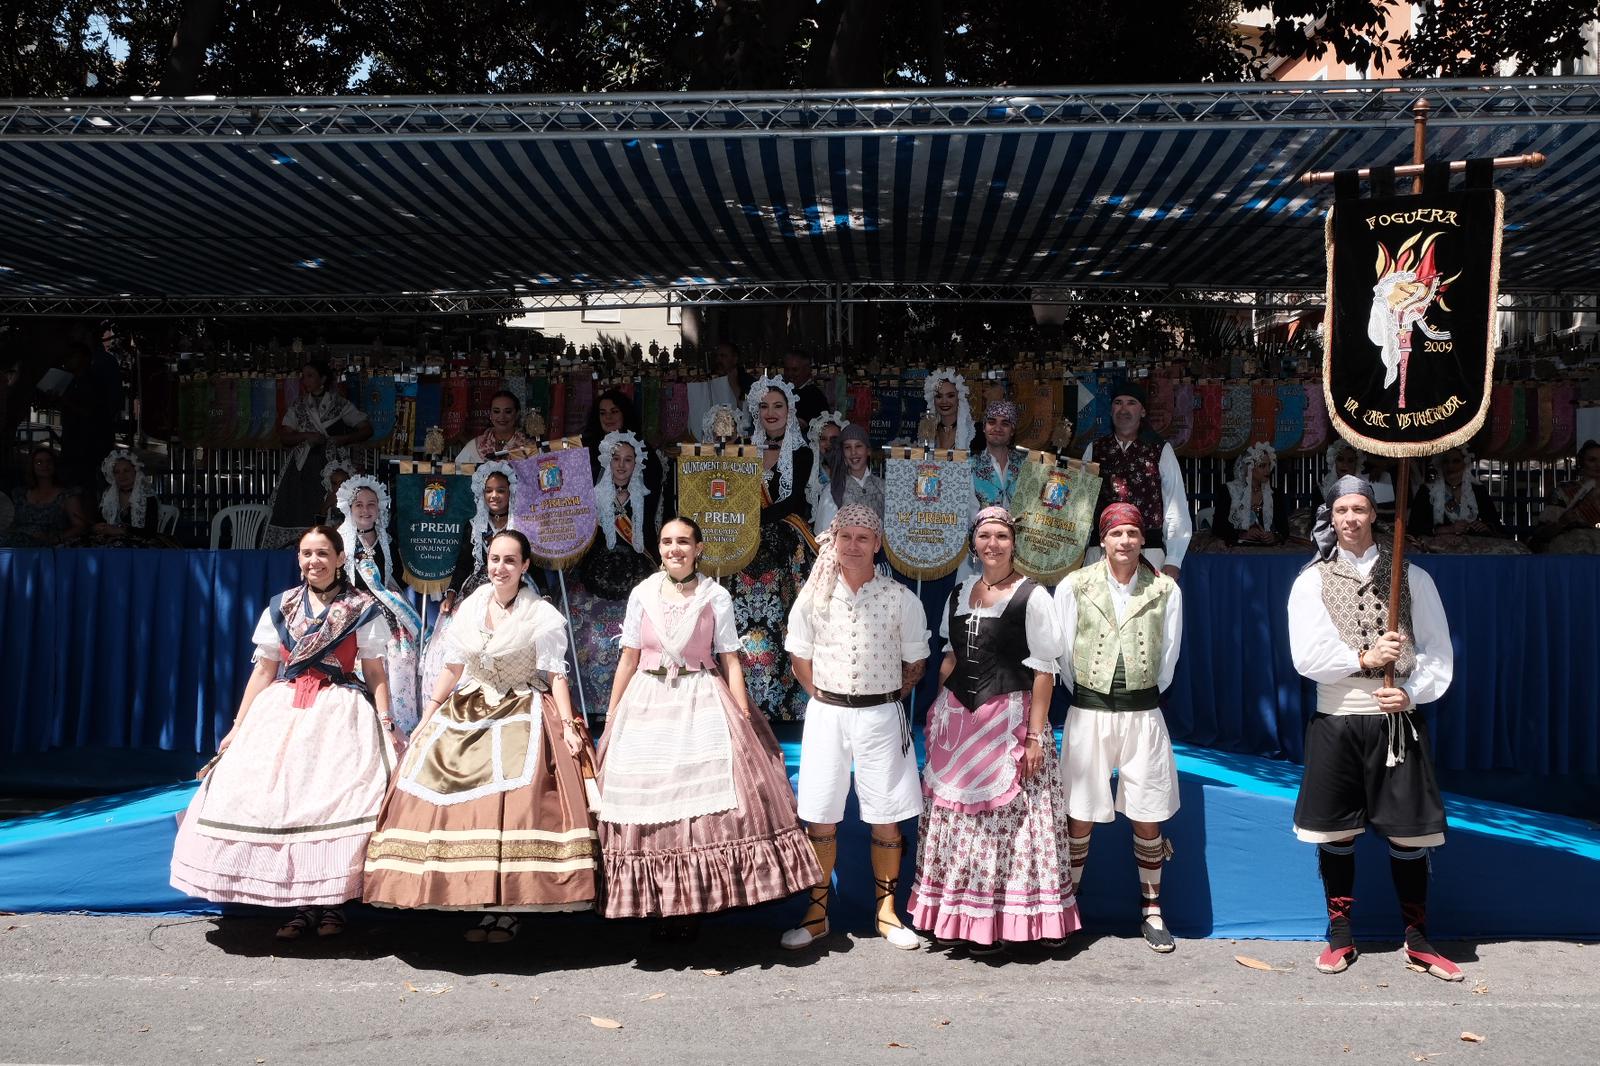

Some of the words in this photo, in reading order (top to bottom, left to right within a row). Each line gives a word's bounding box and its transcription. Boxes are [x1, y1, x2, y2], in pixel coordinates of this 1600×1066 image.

[1366, 208, 1460, 230] FOGUERA
[1424, 341, 1453, 353] 2009
[541, 496, 581, 510] PREMI
[705, 512, 746, 524] PREMI
[917, 511, 958, 525] PREMI
[1034, 512, 1077, 532] PREMI
[420, 522, 460, 534] PREMI
[414, 545, 452, 553] CONJUNTA
